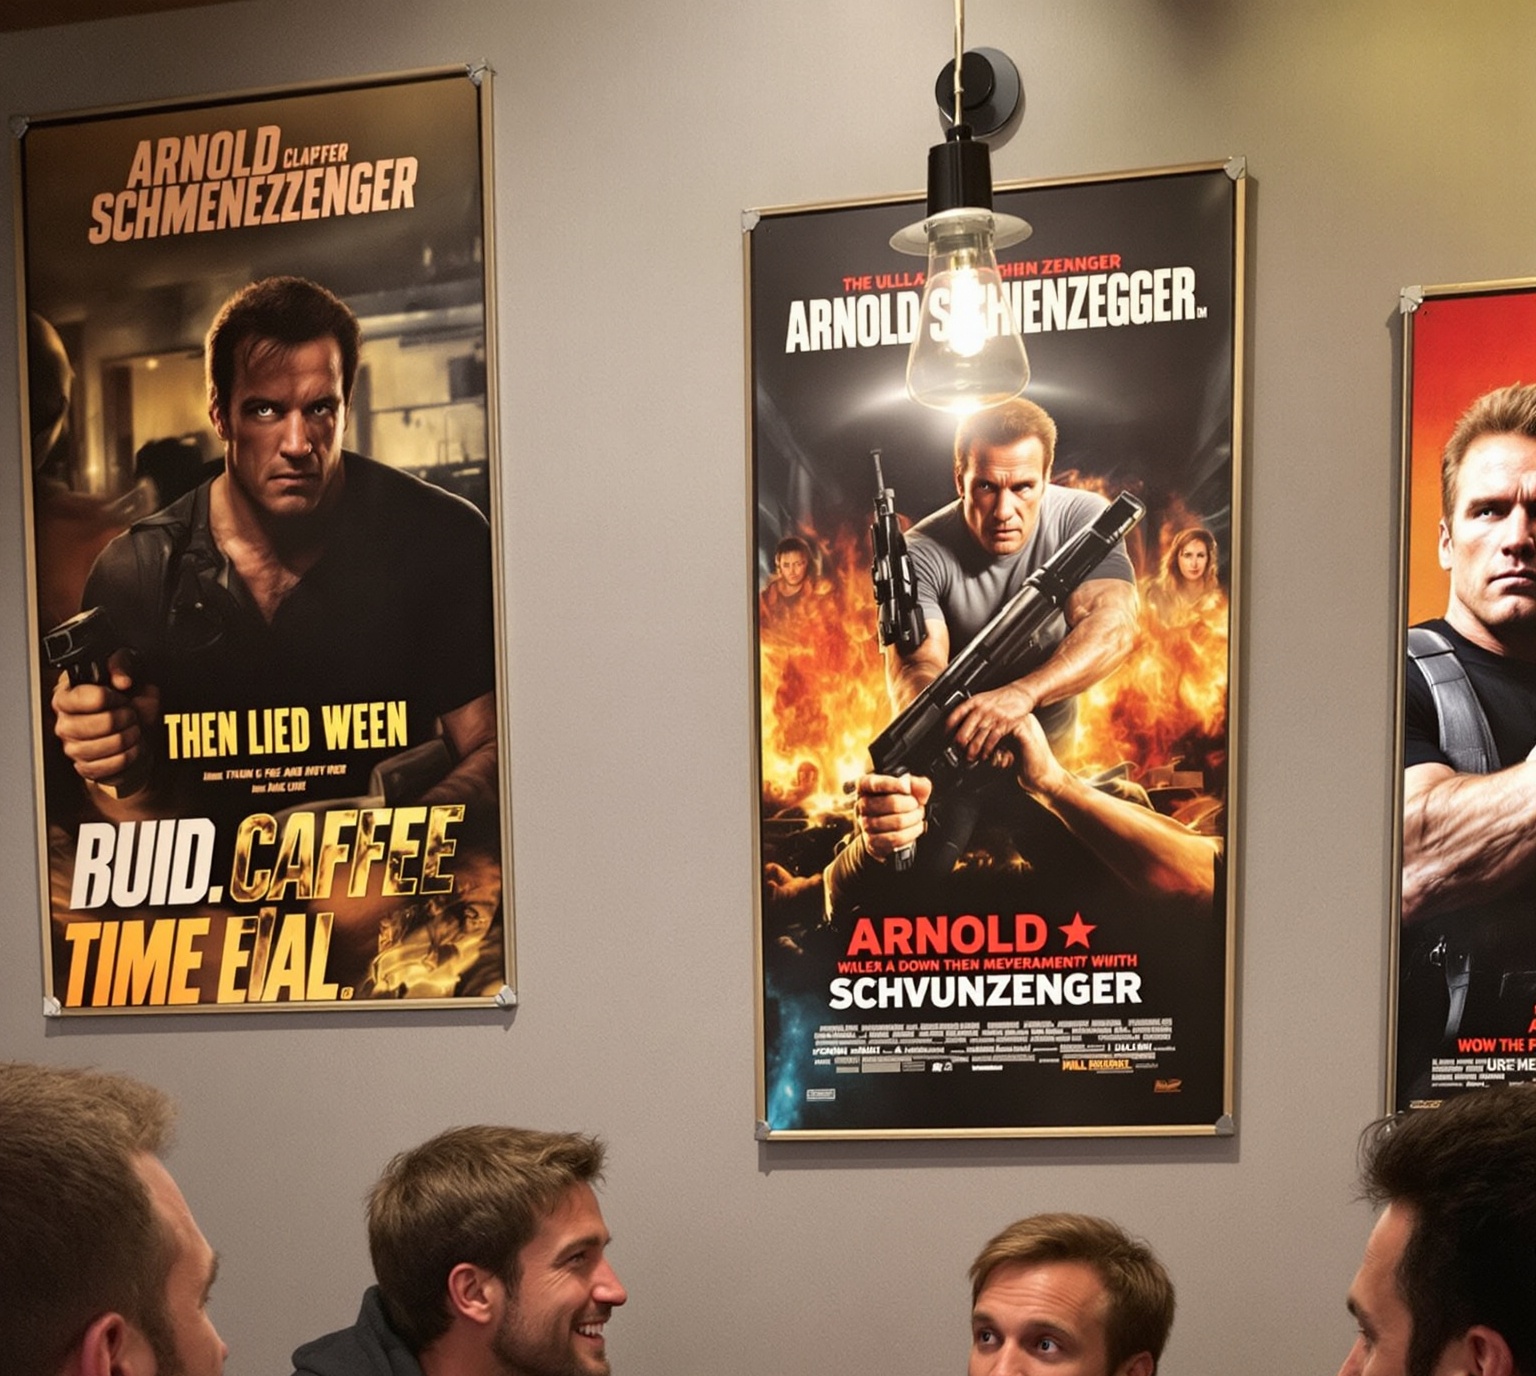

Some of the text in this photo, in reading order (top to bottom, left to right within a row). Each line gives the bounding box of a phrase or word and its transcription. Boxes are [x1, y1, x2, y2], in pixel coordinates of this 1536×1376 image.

[126, 125, 281, 190] ARNOLD
[88, 156, 418, 245] SCHMENEZZENGER
[842, 276, 872, 292] THE
[785, 291, 921, 353] ARNOLD
[164, 701, 408, 760] THEN LIED WEEN
[229, 805, 466, 902] CAFFEE
[65, 917, 210, 1008] TIME
[846, 914, 1048, 956] ARNOLD
[828, 971, 1143, 1011] SCHVUNZENGER
[885, 960, 895, 972] A
[898, 959, 940, 972] DOWN
[943, 958, 980, 971] THEN
[1458, 1038, 1497, 1053] WOW
[1499, 1038, 1524, 1052] THE
